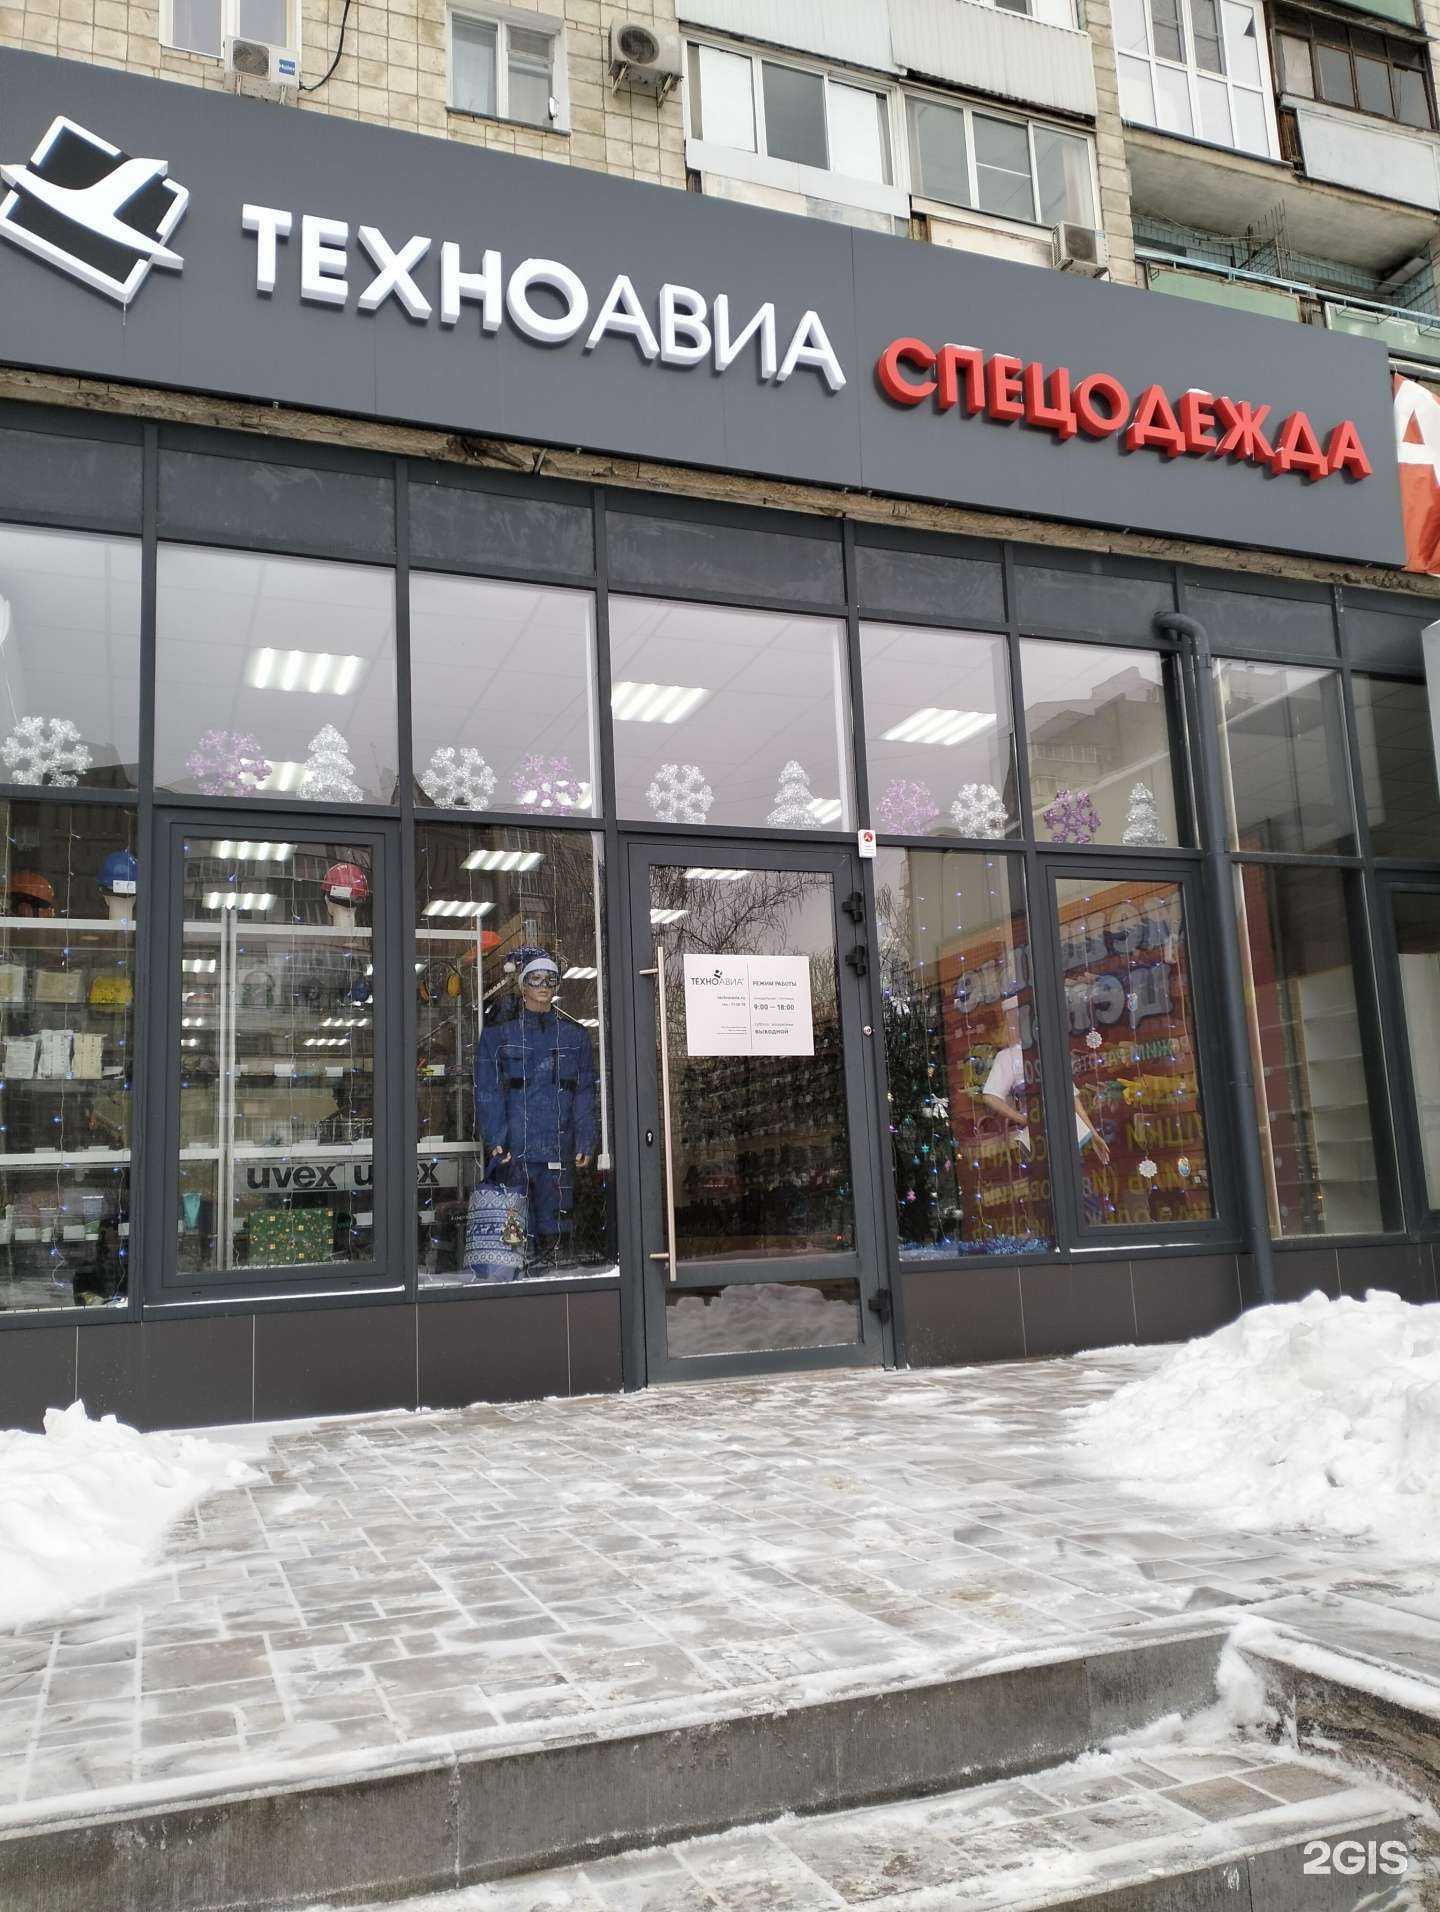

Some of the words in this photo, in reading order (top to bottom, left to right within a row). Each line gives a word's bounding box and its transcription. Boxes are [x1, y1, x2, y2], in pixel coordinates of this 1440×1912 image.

[242, 203, 847, 391] ТЕХНОАВИА
[876, 337, 1373, 481] СПЕЦОДЕЖДА
[690, 977, 744, 986] ТЕХНОАВИА
[247, 1166, 338, 1190] uvex
[354, 1162, 440, 1187] ux
